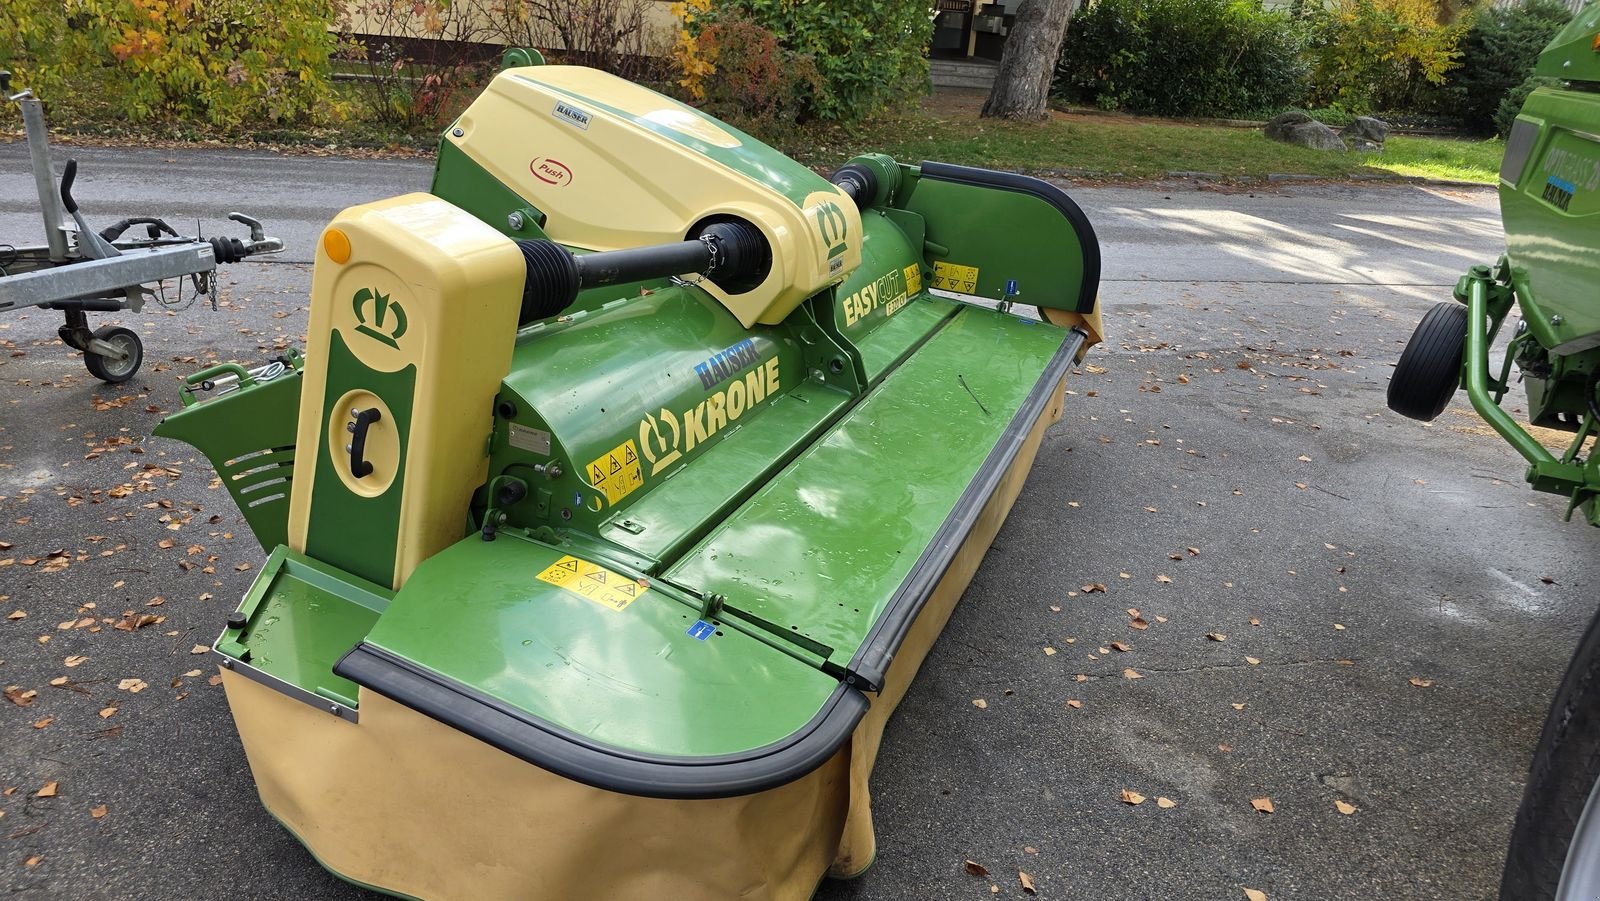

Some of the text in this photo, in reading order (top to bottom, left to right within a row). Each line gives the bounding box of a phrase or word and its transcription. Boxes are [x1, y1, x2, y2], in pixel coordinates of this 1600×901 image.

[556, 104, 588, 124] HAUSER
[538, 163, 564, 180] Push
[694, 338, 761, 391] HAUSER
[683, 355, 779, 453] KRONE
